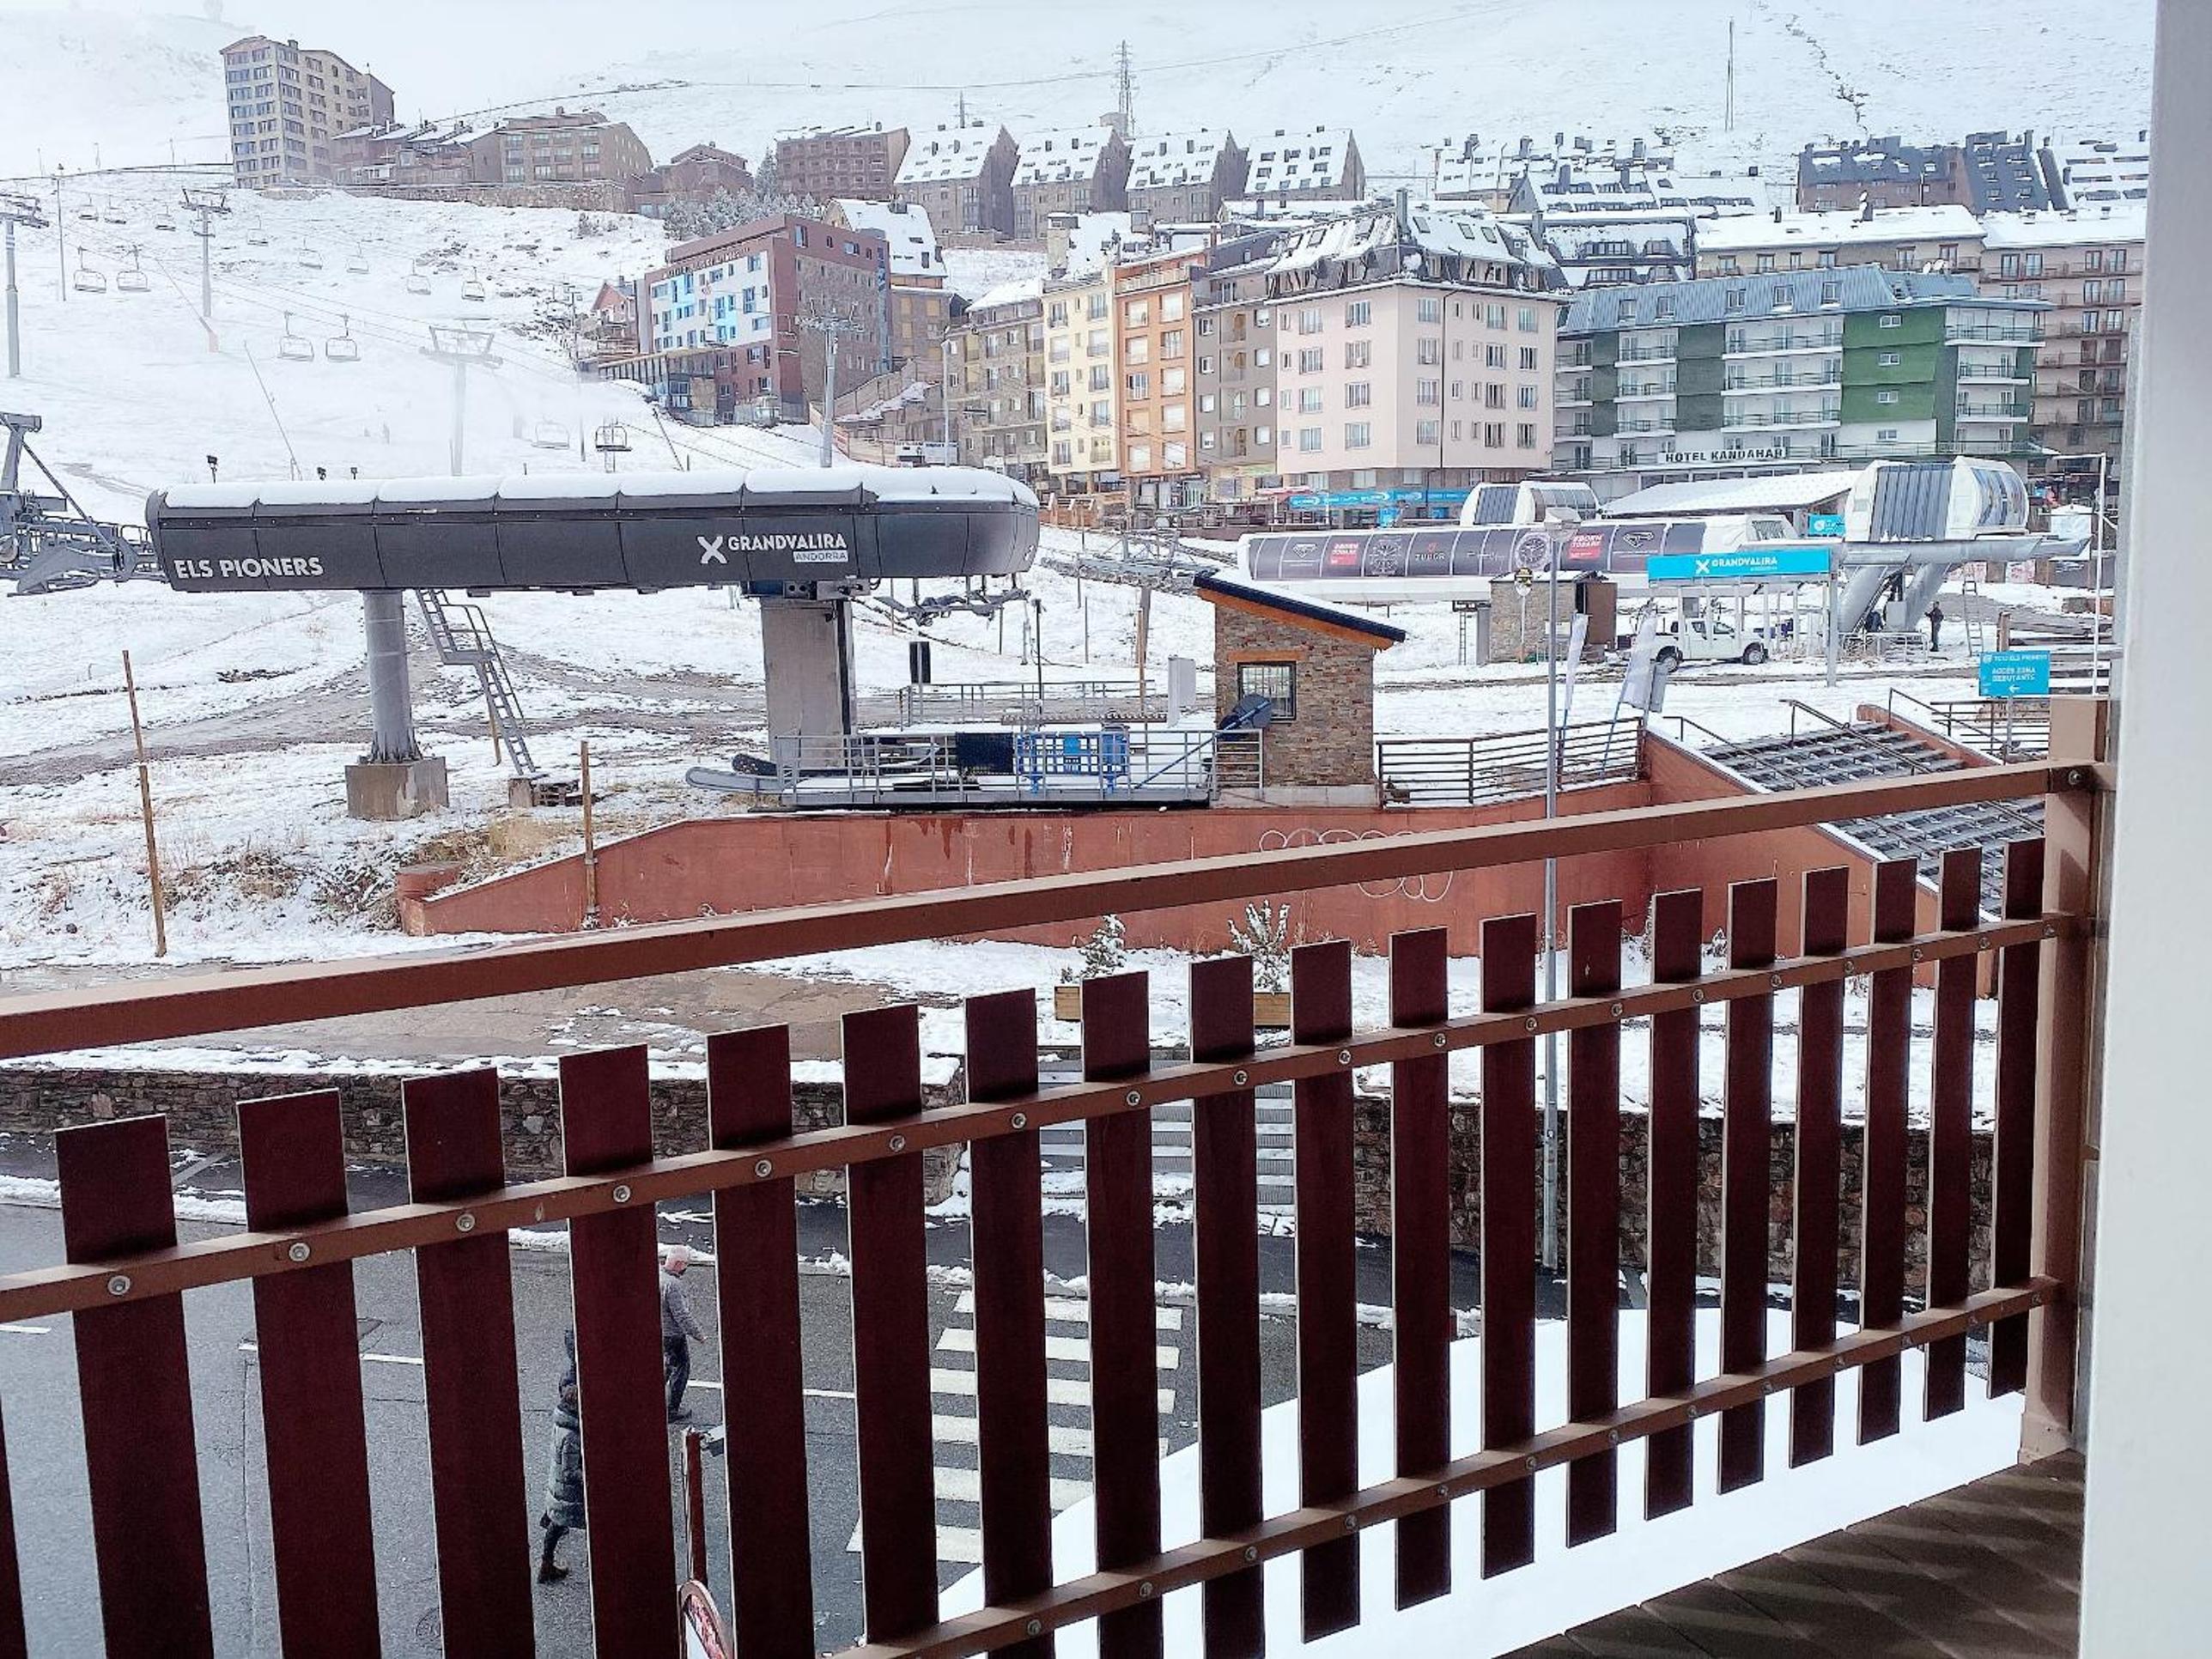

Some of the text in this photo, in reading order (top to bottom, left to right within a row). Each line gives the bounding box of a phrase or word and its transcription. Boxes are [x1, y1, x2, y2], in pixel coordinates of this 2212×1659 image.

[1665, 452, 1707, 463] HOTEL
[728, 533, 848, 551] GRANDVALIRA
[794, 551, 847, 562] ANDORRA
[1711, 556, 1778, 568] GRANDVALIRA
[173, 556, 325, 580] ELS PIONERS
